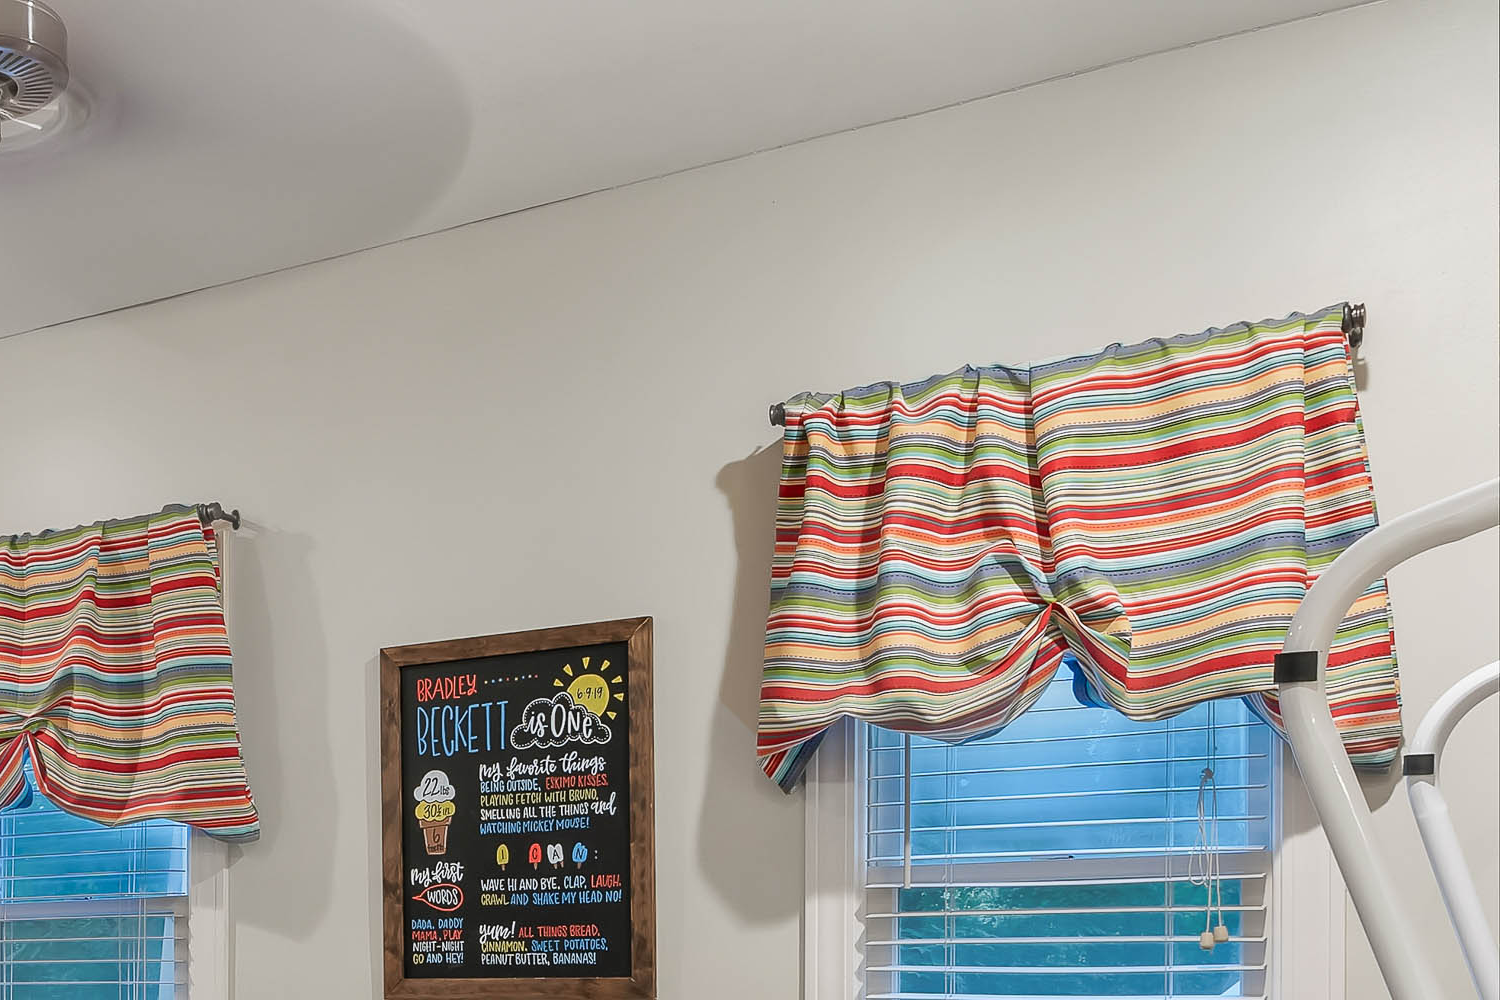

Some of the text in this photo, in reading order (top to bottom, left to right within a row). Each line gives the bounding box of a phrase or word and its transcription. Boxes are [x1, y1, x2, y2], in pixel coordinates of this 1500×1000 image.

[417, 674, 478, 702] BRADLEY
[417, 701, 509, 757] BECKETT
[524, 711, 548, 738] is
[479, 751, 607, 782] my favorite things
[423, 777, 440, 797] 22
[480, 781, 504, 793] BEING
[546, 776, 576, 790] ESKIMO
[480, 794, 514, 807] PLAYING
[515, 792, 542, 805] FETCH
[544, 790, 567, 803] WITH
[480, 792, 617, 821] SMELLING ALL THE THINGS and
[480, 817, 589, 834] WATCHING MICKEY MOUSE!
[433, 828, 440, 842] 6
[411, 861, 464, 887] my first
[480, 878, 505, 891] WAVE
[507, 878, 517, 891] HI
[519, 878, 538, 891] AND
[427, 888, 458, 905] WORDS
[481, 889, 622, 905] CRAWL AND SHAKE MY HEAD NO!
[438, 918, 464, 929] DADDY
[443, 929, 463, 940] PLAY
[479, 921, 516, 944] yum!
[518, 927, 534, 938] ALL
[537, 925, 568, 938] THINGS
[412, 941, 464, 952] NIGHT-NIGHT
[531, 939, 560, 952] SWEET
[412, 952, 464, 965] GO AND HEY!
[481, 952, 596, 966] PEANUT BUTTER, BANANAS!
